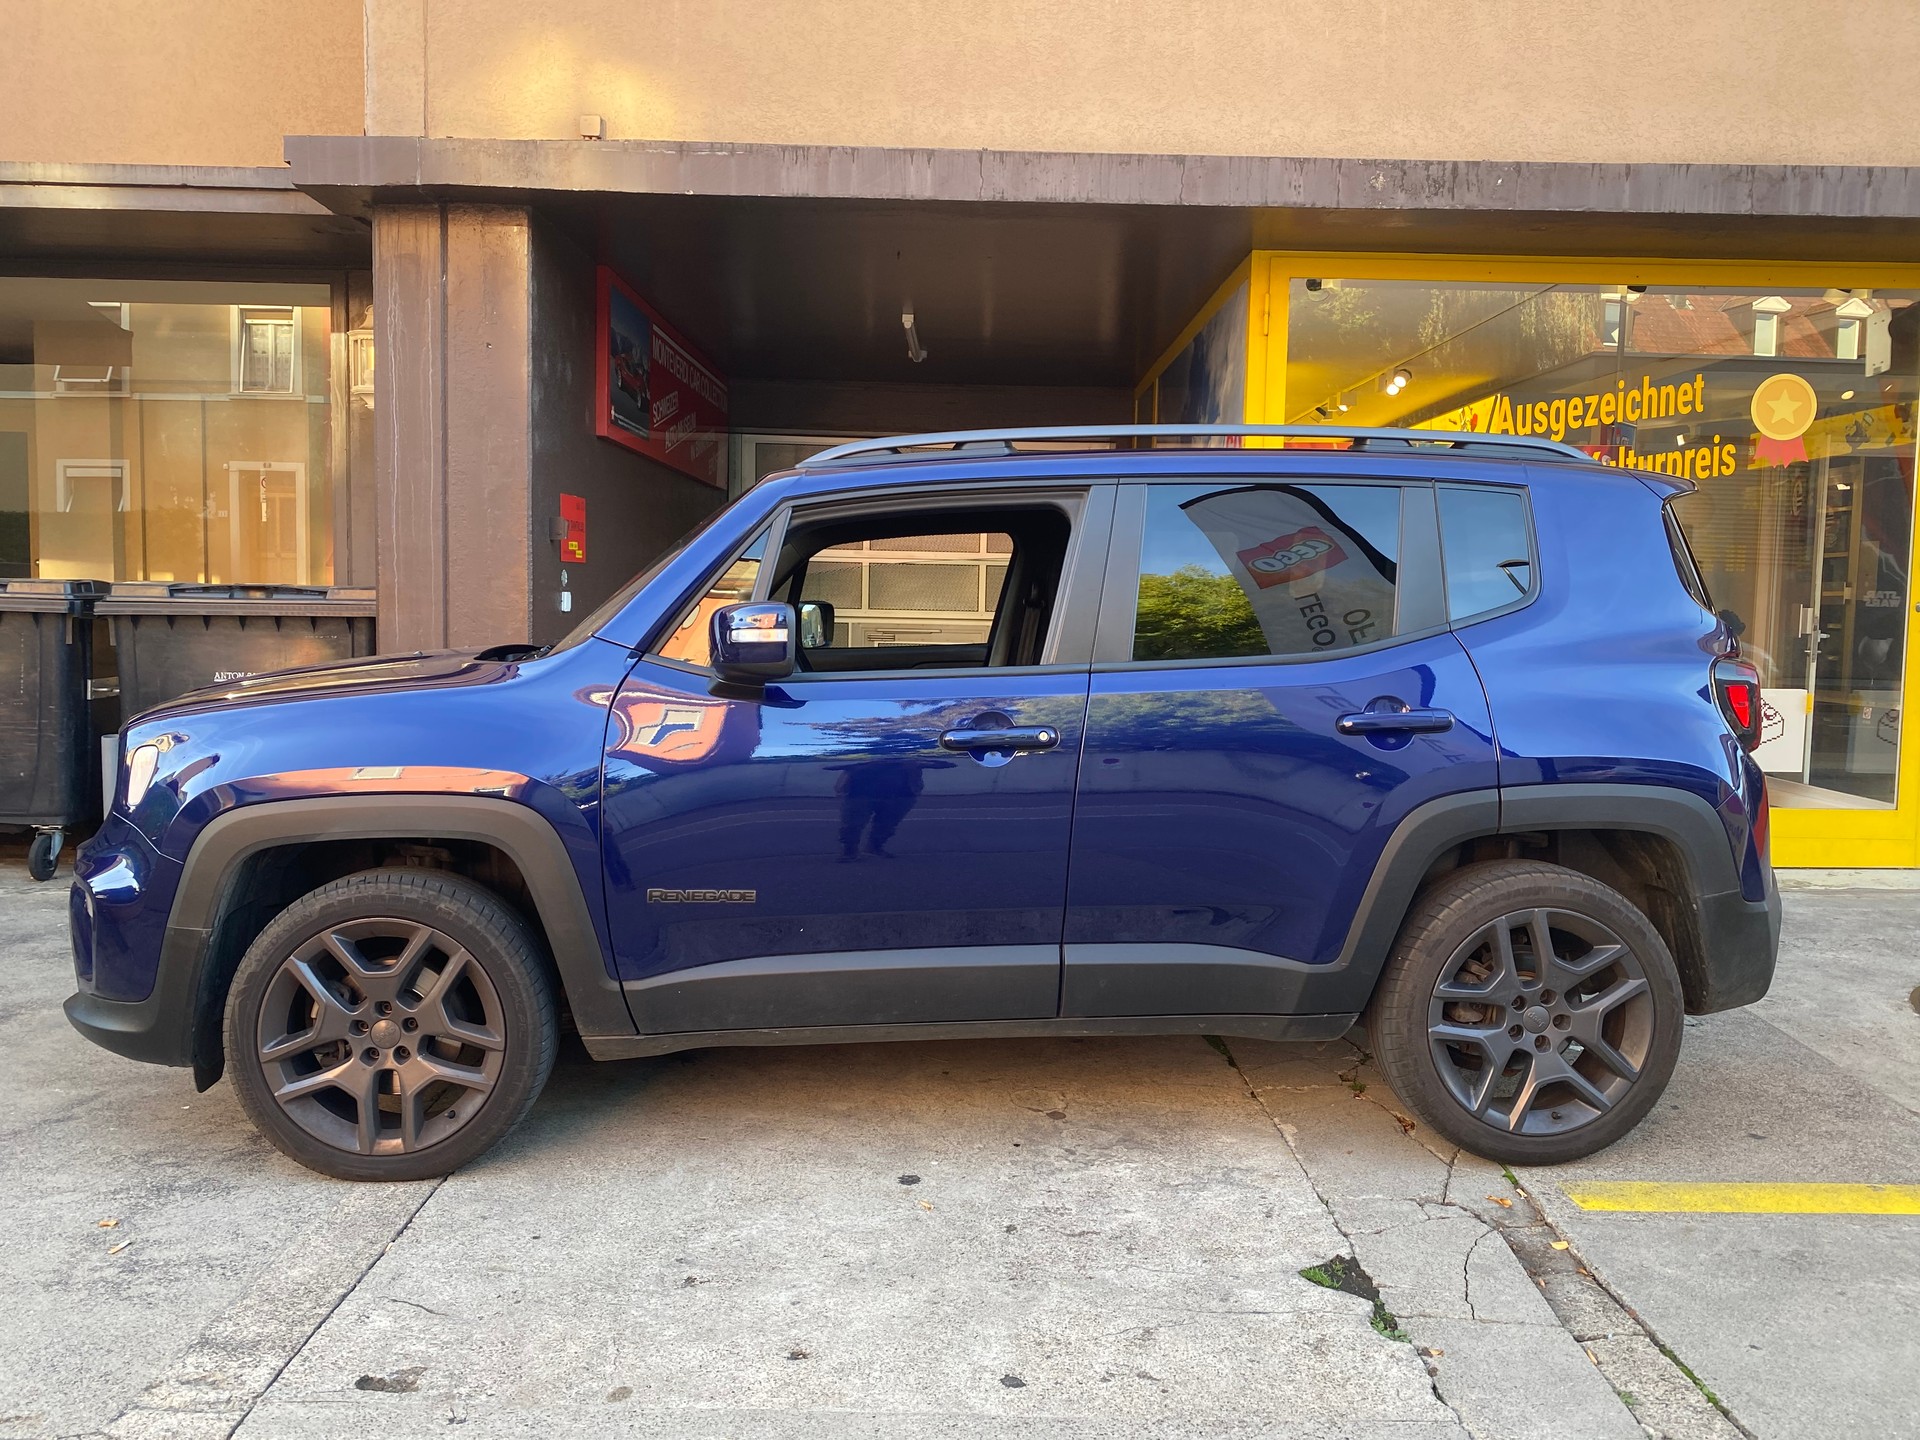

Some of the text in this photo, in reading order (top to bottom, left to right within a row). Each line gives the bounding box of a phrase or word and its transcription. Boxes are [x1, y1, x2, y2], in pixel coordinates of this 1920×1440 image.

[652, 334, 689, 385] MONTEVERDI
[689, 365, 701, 394] CAR
[652, 391, 679, 423] SCHWEIZER
[1497, 373, 1705, 442] Ausgezeichnet
[1591, 434, 1737, 480] lturpreis
[213, 671, 245, 680] ANTON
[647, 888, 757, 903] RENEGADE
